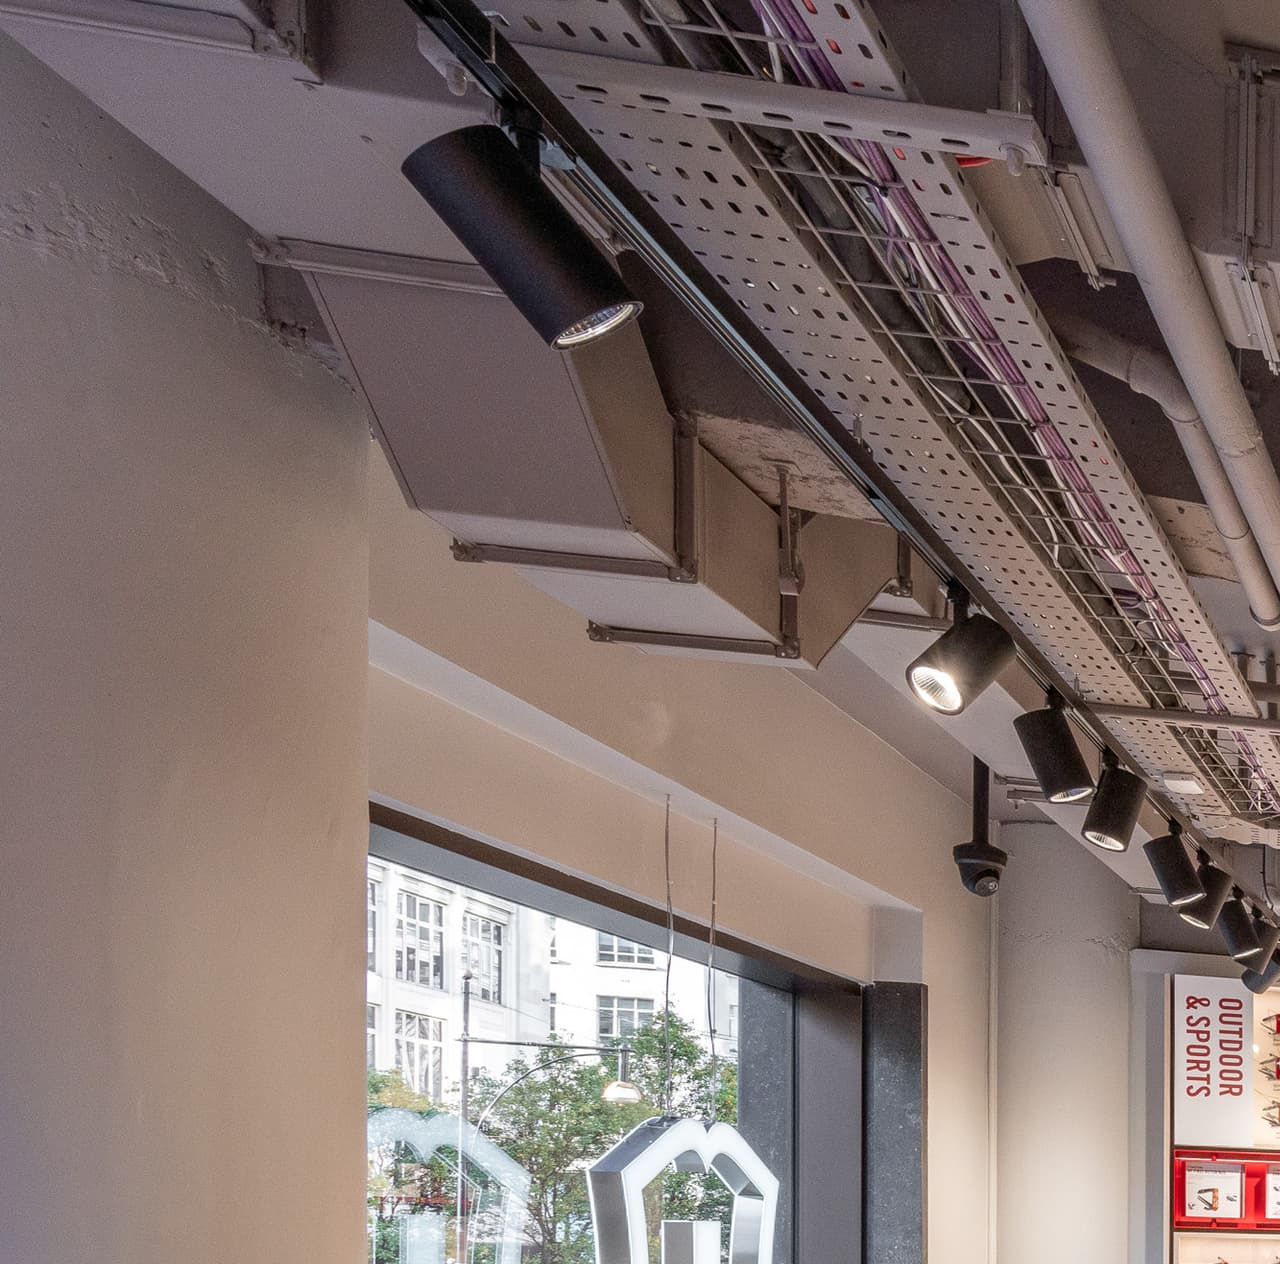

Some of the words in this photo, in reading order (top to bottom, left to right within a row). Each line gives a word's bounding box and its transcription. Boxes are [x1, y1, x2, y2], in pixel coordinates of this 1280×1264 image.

[1186, 995, 1211, 1010] &
[1186, 1015, 1211, 1097] SPORTS
[1218, 997, 1243, 1096] OUTDOOR
